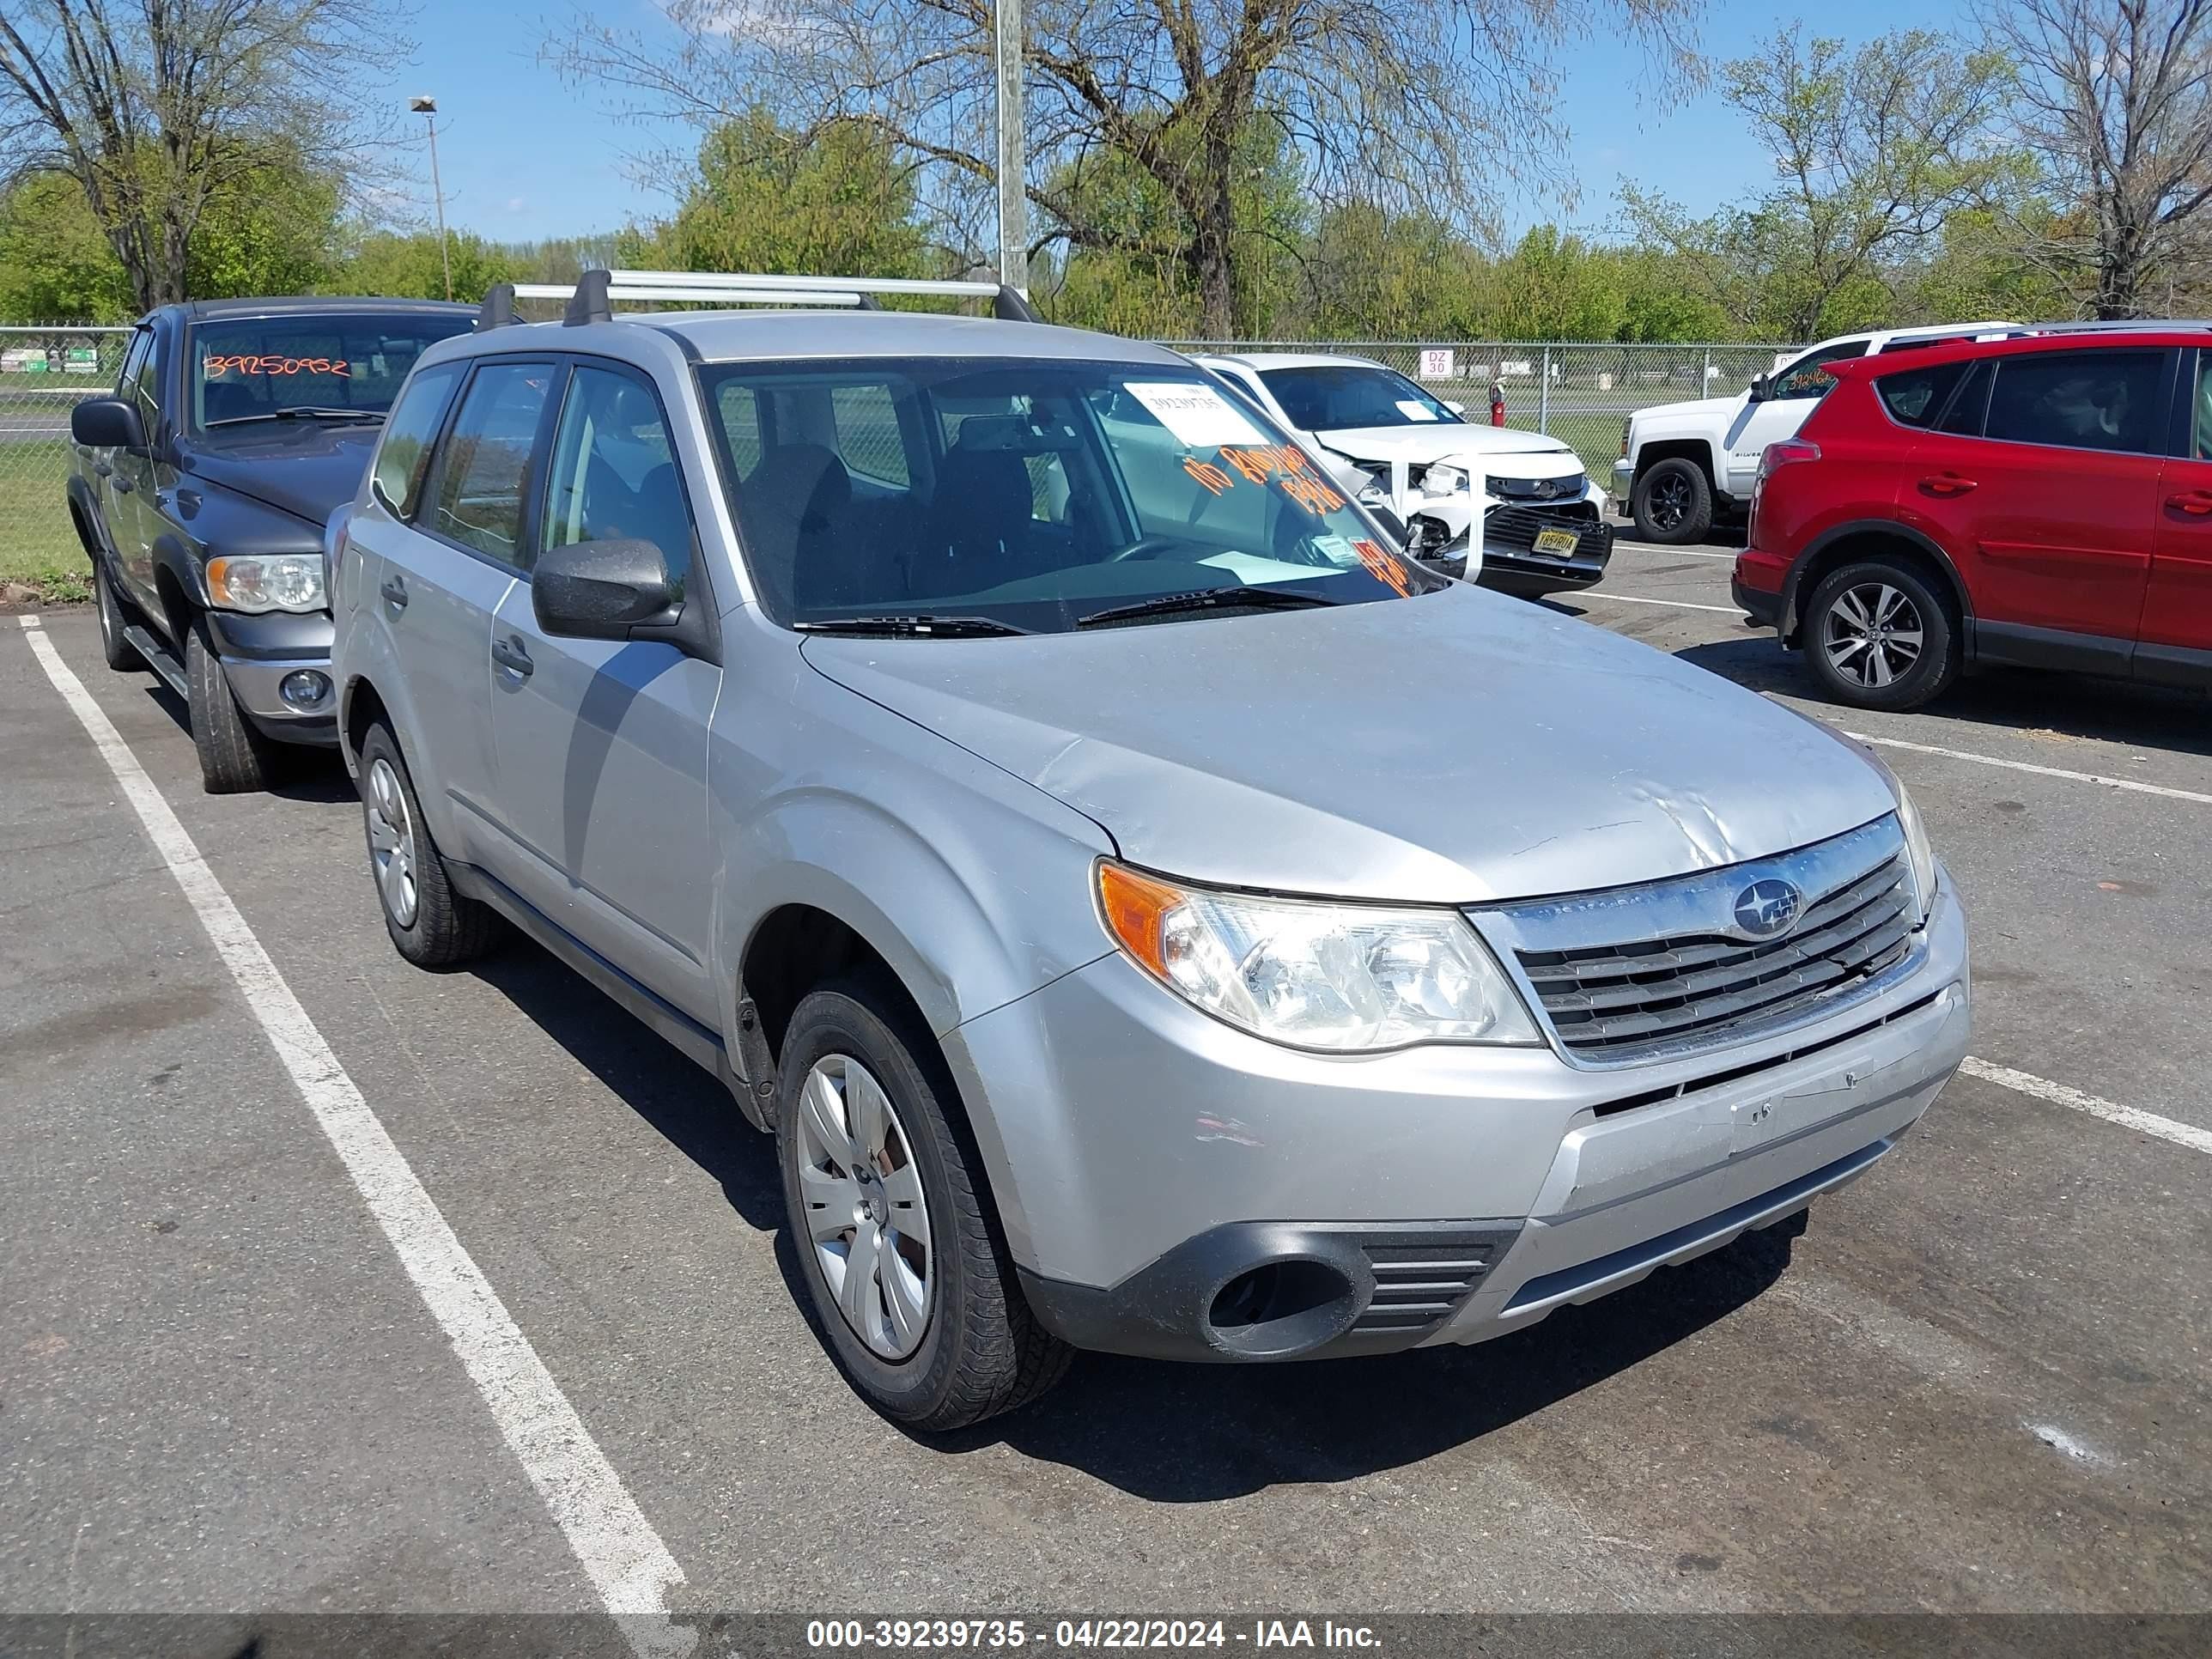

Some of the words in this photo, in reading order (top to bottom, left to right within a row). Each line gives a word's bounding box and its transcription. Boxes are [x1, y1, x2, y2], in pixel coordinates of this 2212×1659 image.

[1429, 352, 1446, 362] DZ
[203, 355, 352, 378] 39250952
[1430, 362, 1444, 373] 30
